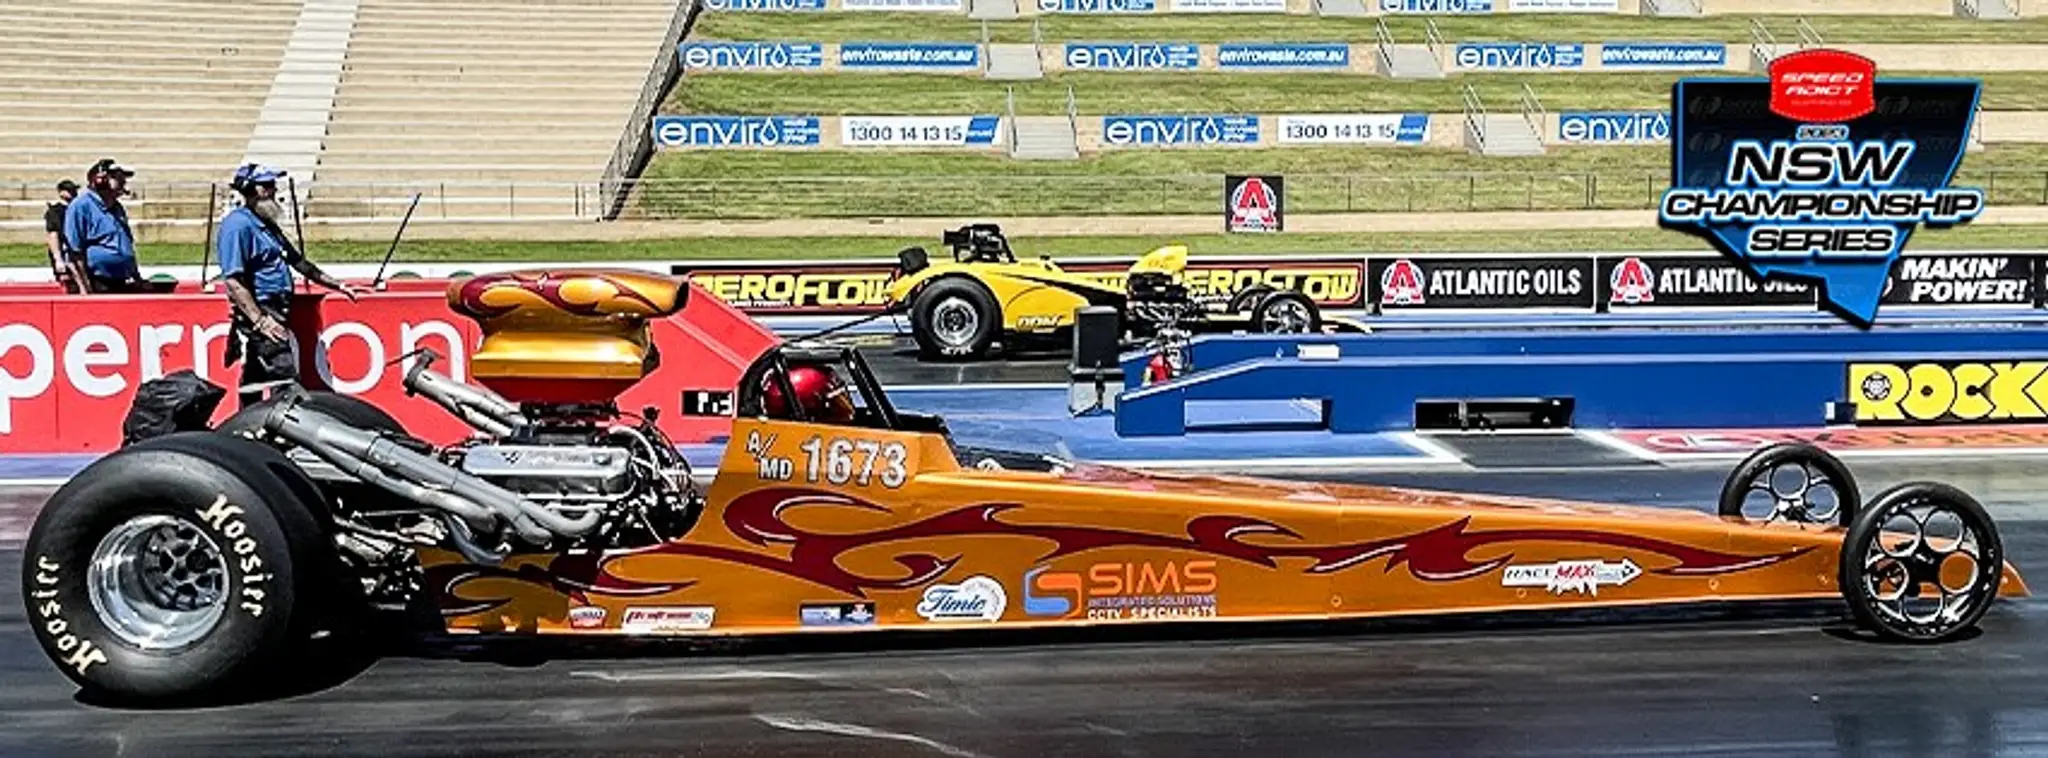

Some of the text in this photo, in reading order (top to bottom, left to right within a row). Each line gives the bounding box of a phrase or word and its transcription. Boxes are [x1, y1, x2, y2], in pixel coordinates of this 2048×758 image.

[686, 44, 788, 67] enviro
[1069, 44, 1166, 67] enviro
[1459, 44, 1551, 67] enviro
[661, 117, 778, 145] enviro
[851, 125, 892, 140] 1300
[900, 126, 918, 140] 14
[923, 125, 940, 140] 13
[945, 125, 963, 140] 15
[1108, 116, 1220, 143] enviro
[1286, 125, 1327, 139] 1300
[1334, 125, 1350, 139] 14
[1355, 125, 1372, 139] 13
[1378, 125, 1395, 139] 15
[1562, 113, 1669, 140] enviro
[1429, 269, 1530, 295] ATLANTIC
[1533, 268, 1581, 295] OILS
[1901, 258, 2009, 280] MAKIN'
[1911, 279, 2028, 302] POWER!
[801, 434, 908, 489] 1673
[196, 494, 273, 617] Hoosier
[1089, 561, 1217, 596] SIMS
[31, 556, 107, 675] Hoosier
[1088, 605, 1217, 620] CCTV SPECIALISTS
